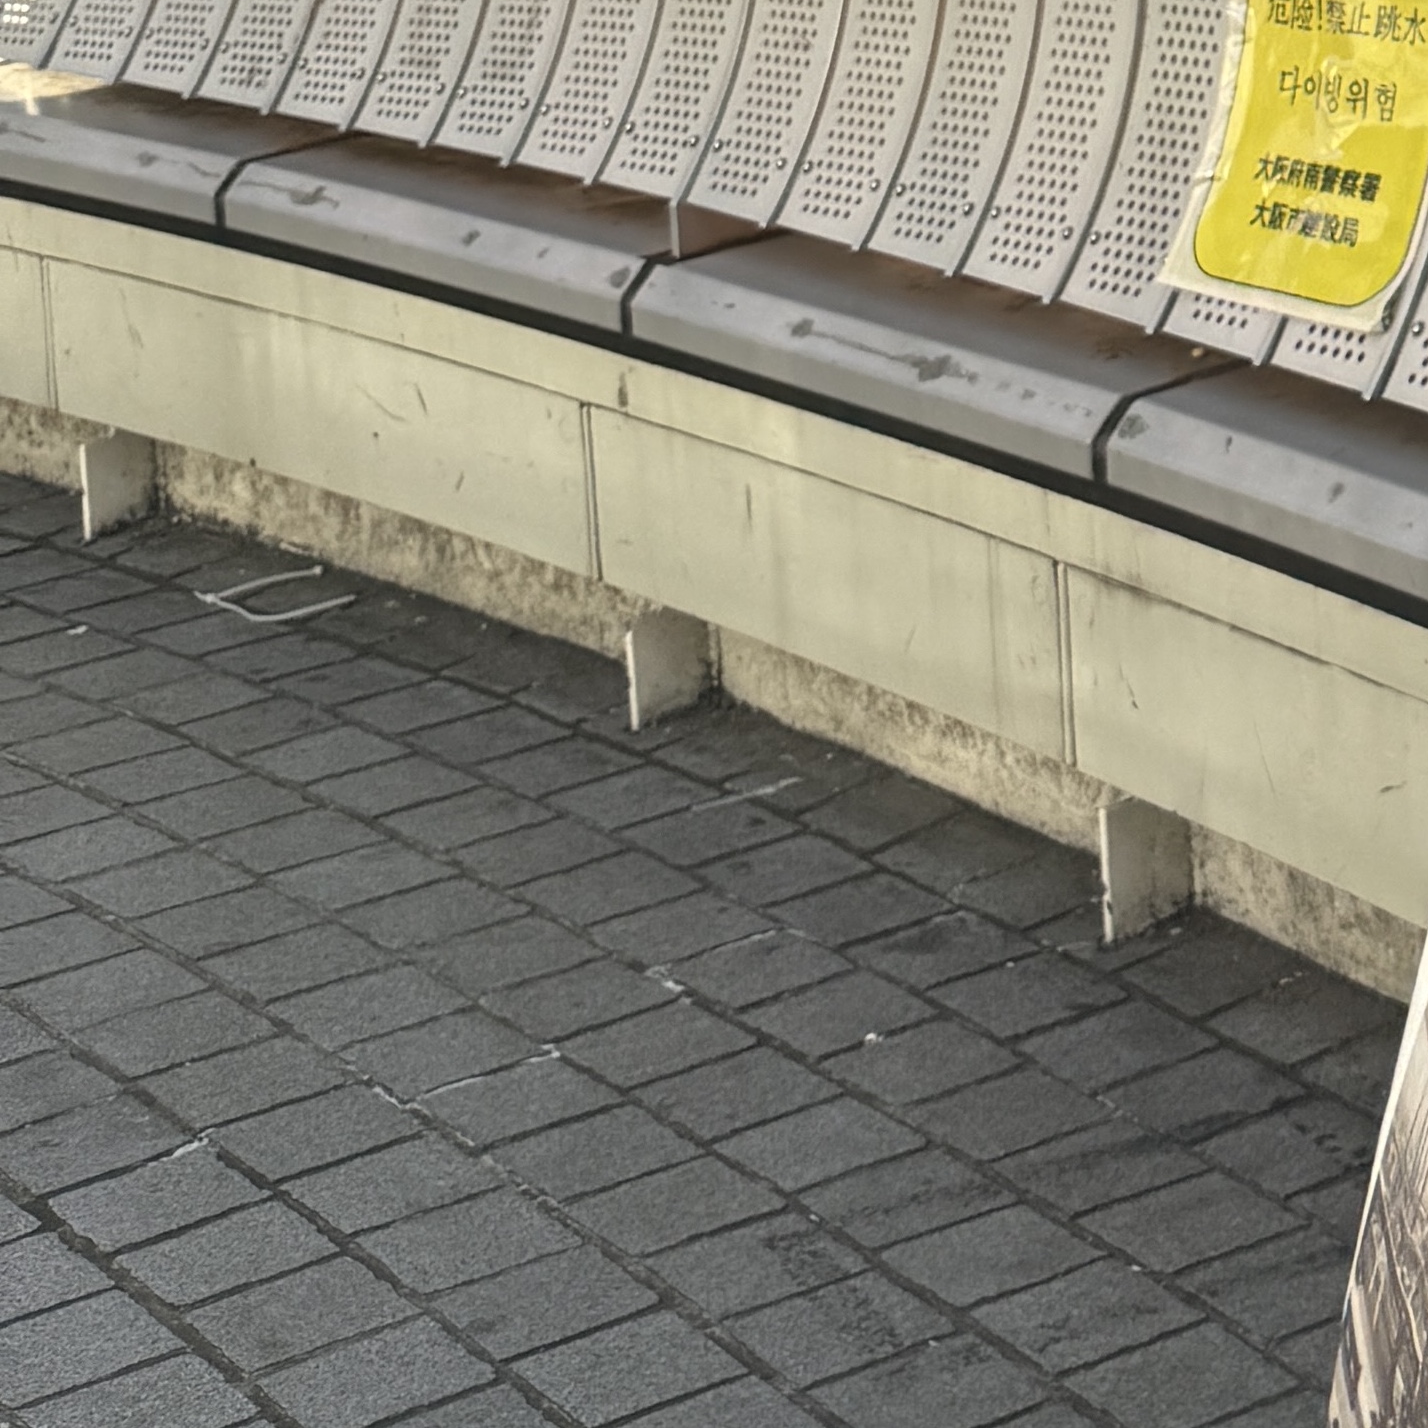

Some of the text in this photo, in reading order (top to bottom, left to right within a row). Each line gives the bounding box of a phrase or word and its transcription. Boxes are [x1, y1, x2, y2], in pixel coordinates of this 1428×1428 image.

[1253, 151, 1383, 203] 大阪府南警察署
